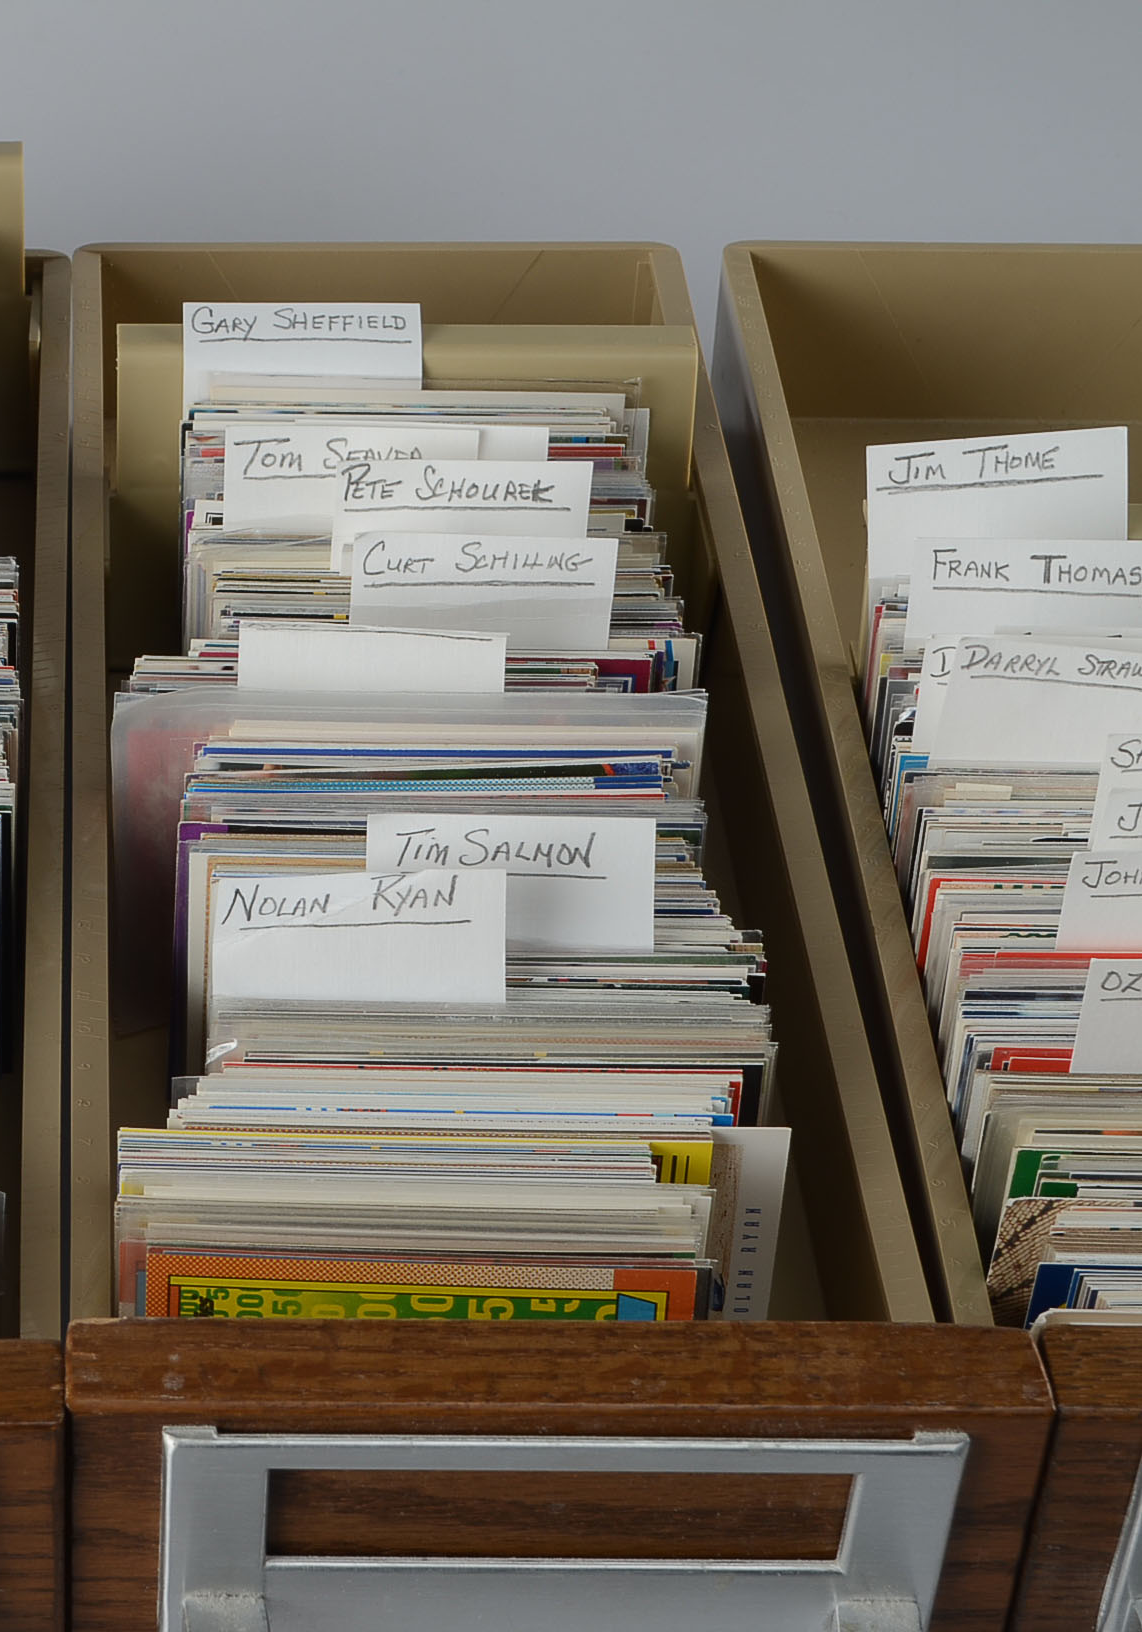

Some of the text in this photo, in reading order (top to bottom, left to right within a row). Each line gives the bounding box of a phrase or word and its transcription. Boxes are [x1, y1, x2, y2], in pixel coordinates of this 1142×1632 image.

[191, 306, 407, 341] GARY SHEFFIELD
[341, 464, 556, 503] PETE SCHOUREK
[888, 444, 1060, 484] JIM THOME
[362, 541, 594, 576] CURT SCHILLING
[932, 548, 1142, 586] FRANK THOMAS
[961, 644, 1060, 676] DARRYL
[459, 828, 596, 868] SALMON
[221, 874, 458, 925] NOLAN RYAN
[733, 1269, 755, 1313] OLAN
